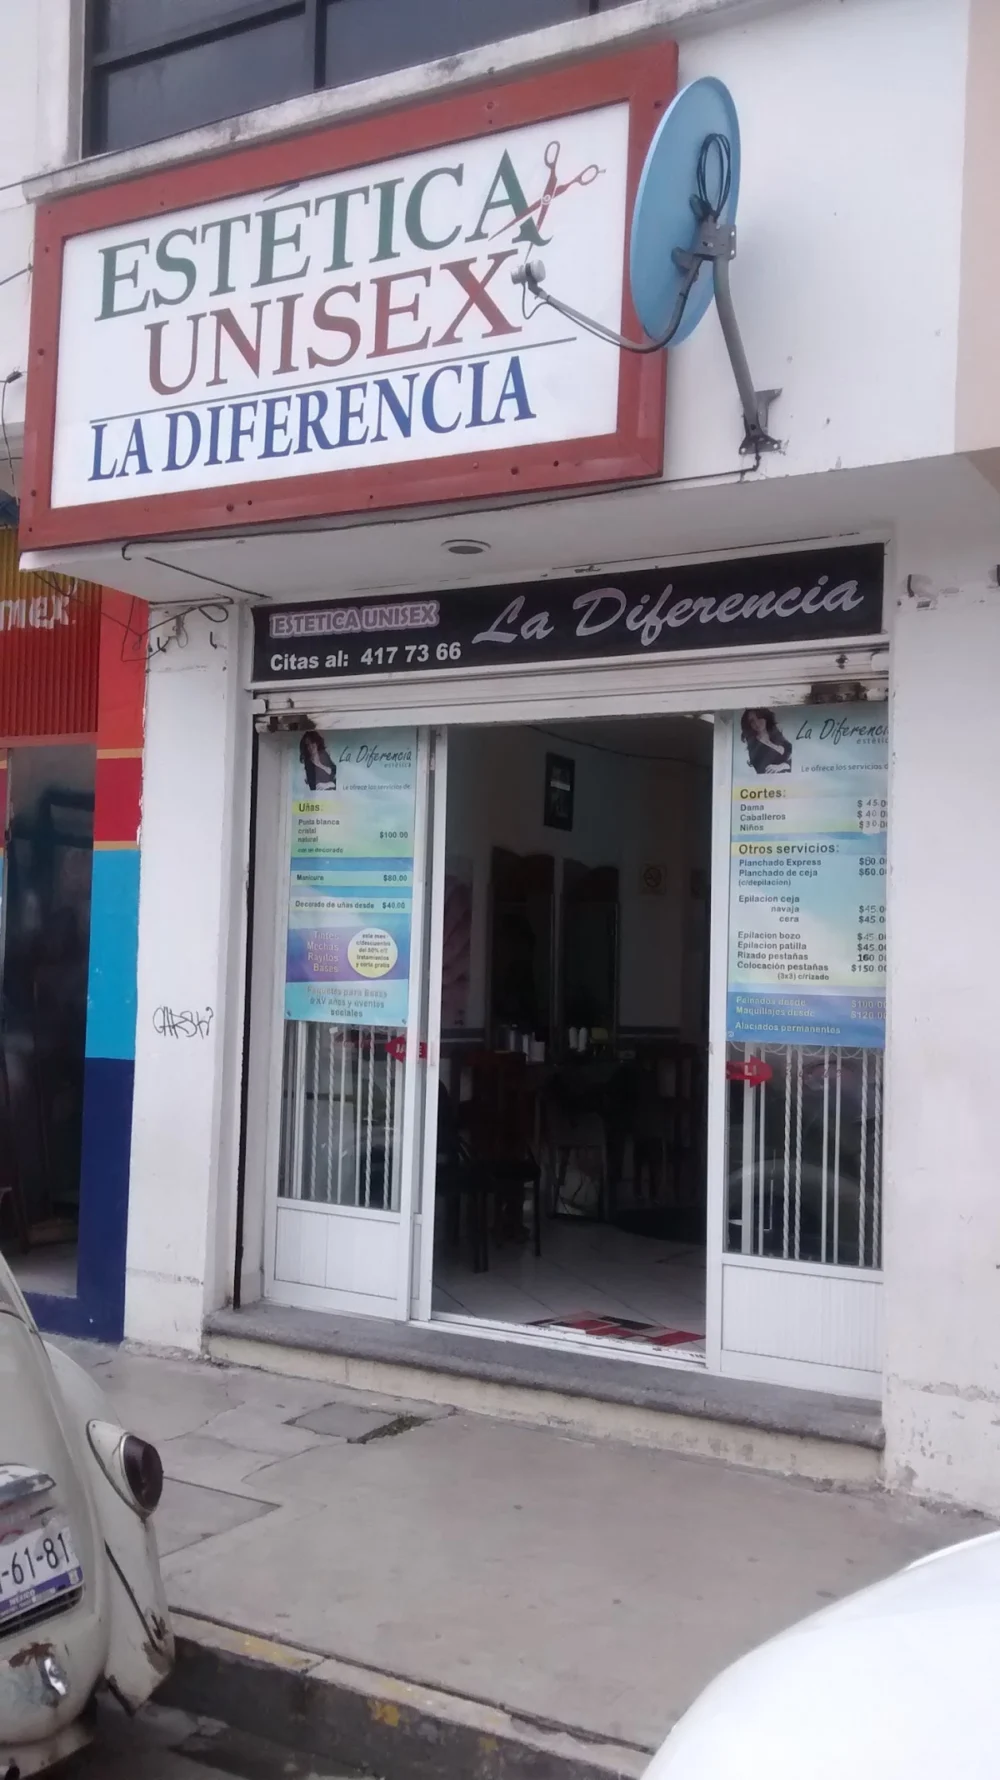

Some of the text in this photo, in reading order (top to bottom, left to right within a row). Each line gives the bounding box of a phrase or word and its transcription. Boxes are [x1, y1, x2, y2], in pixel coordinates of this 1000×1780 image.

[145, 248, 522, 396] UNISEX
[88, 355, 536, 482] LA DIFERENCIA
[471, 575, 864, 646] La Diferencia
[271, 602, 439, 637] ESTETICA UNISEX
[271, 642, 461, 671] Citas al: 417 73 66
[796, 720, 813, 740] La
[339, 745, 412, 768] La Diferencia
[811, 764, 835, 772] ofrece
[835, 763, 847, 771] los
[848, 763, 883, 771] servicios
[740, 788, 787, 800] Cortes:
[740, 804, 765, 812] Dama
[316, 818, 340, 826] blanca
[740, 813, 786, 822] Caballeros
[740, 823, 764, 832] Niños
[739, 842, 840, 855] Otros servicios:
[739, 858, 785, 867] Planchado
[786, 858, 822, 868] Express
[739, 869, 785, 877] Planchado
[786, 869, 797, 877] de
[799, 869, 818, 878] ceja
[295, 900, 325, 908] Decorado
[337, 901, 353, 909] uñas
[355, 901, 375, 909] desde
[780, 895, 800, 904] ceja
[771, 905, 800, 914] navaja
[779, 915, 800, 923] cera
[779, 931, 801, 940] bozo
[779, 942, 807, 951] patilla
[737, 951, 767, 960] Rizado
[768, 952, 809, 962] pestañas
[313, 963, 339, 973] Bases
[737, 961, 829, 972] Colocación pestañas
[778, 972, 830, 981] (3x3) c/rizado
[330, 1009, 363, 1018] sociales
[736, 1006, 786, 1017] Maquillajes
[788, 1008, 815, 1017] desde
[735, 1021, 841, 1034] Alaciados permanentes
